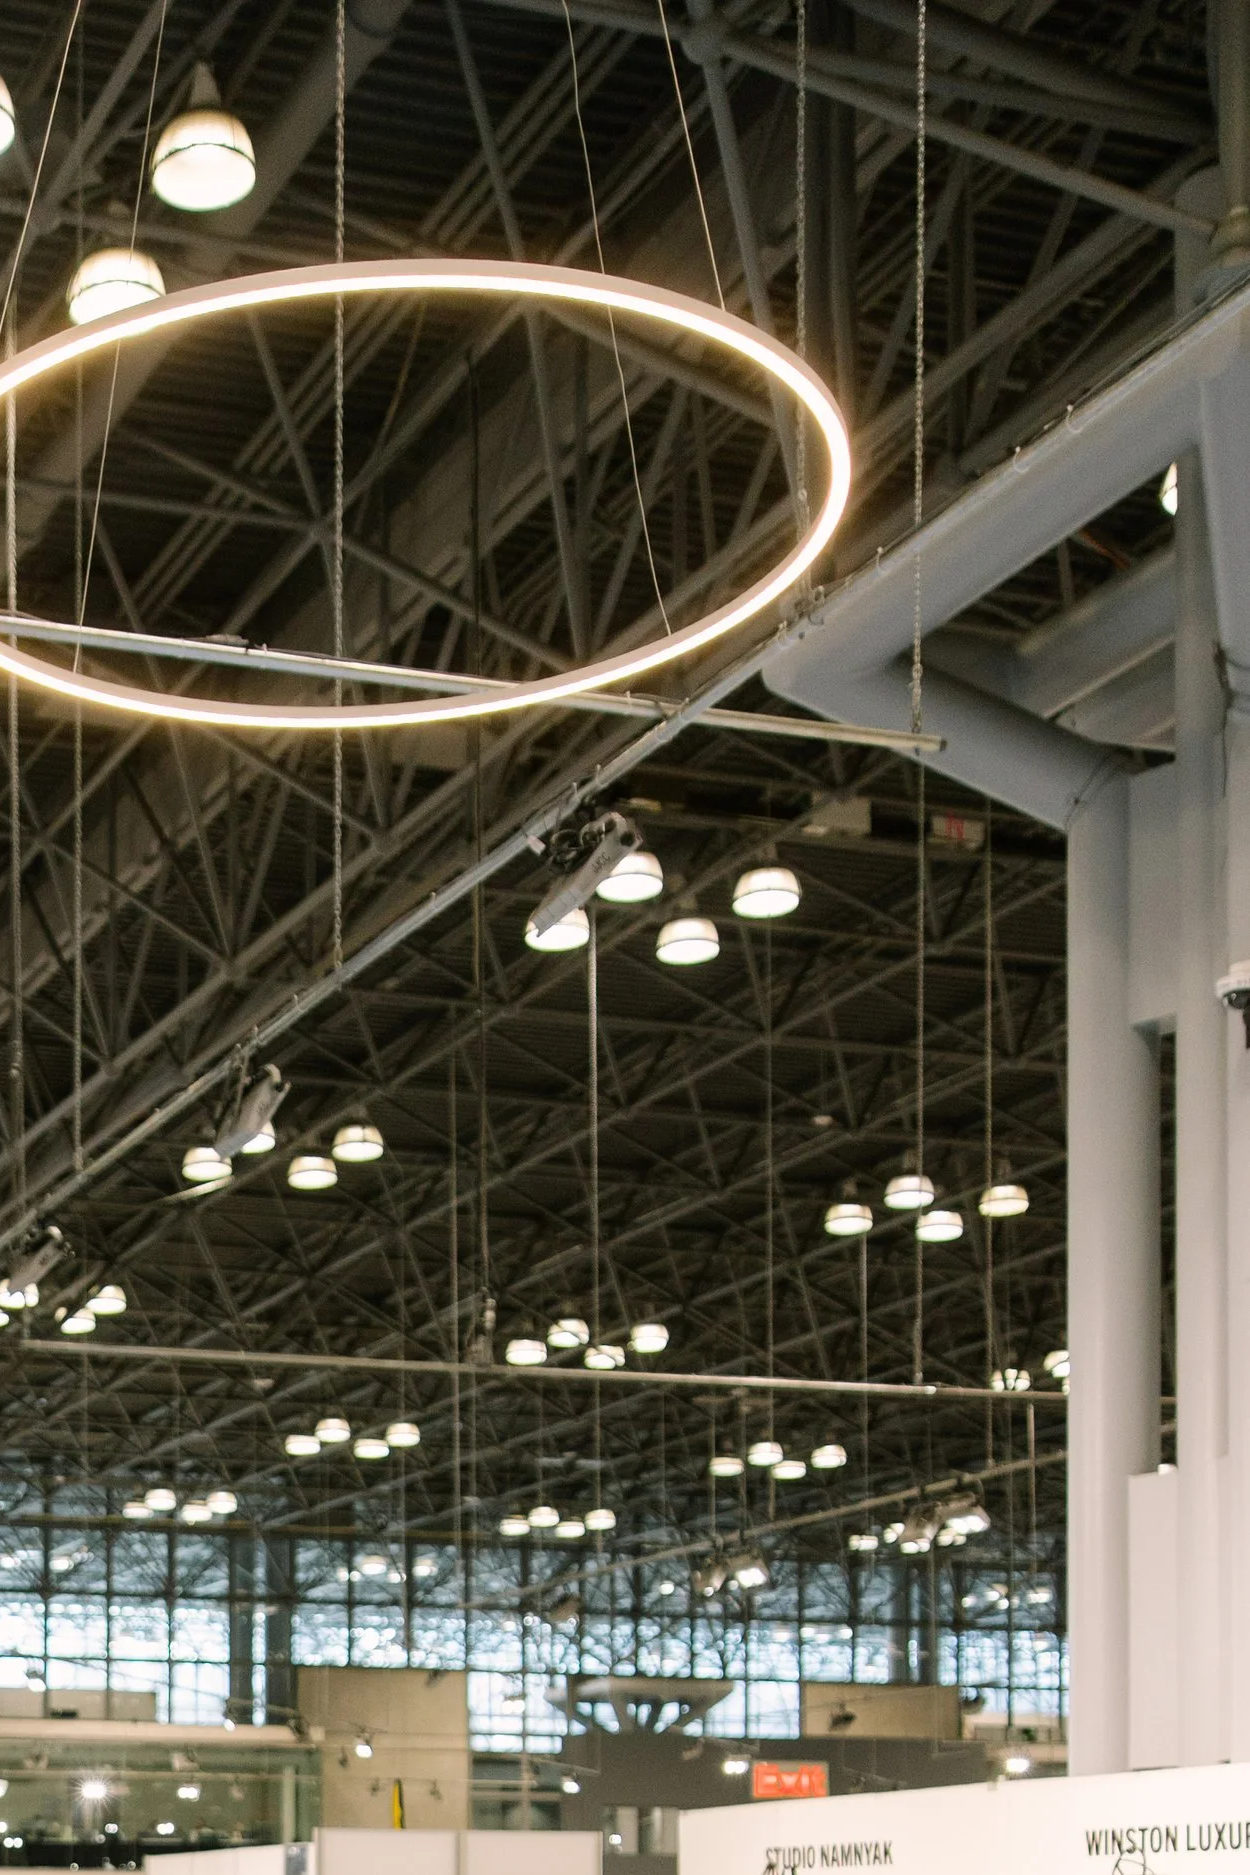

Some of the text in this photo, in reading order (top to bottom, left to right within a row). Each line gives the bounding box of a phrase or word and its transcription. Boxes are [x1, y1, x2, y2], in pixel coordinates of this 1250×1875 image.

[766, 1841, 893, 1870] STUDIO NAMNYAK
[1086, 1825, 1178, 1856] WINSTON
